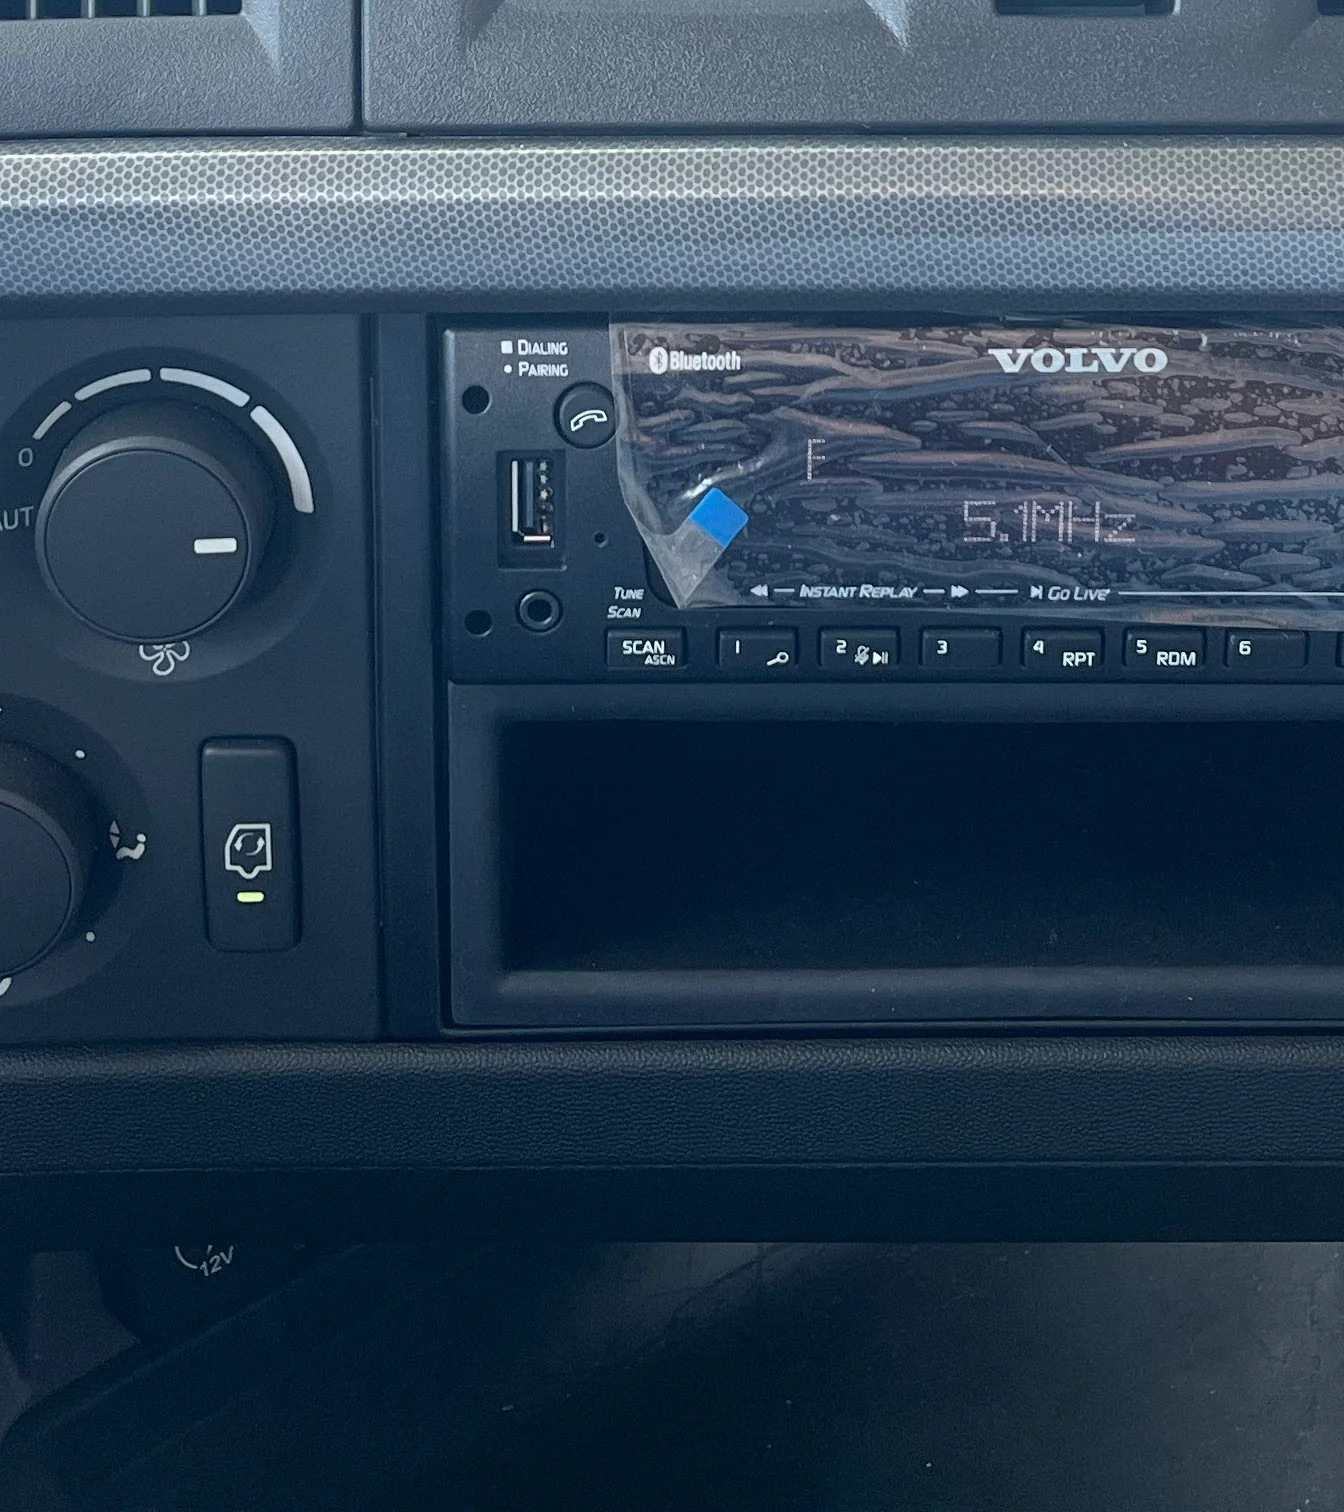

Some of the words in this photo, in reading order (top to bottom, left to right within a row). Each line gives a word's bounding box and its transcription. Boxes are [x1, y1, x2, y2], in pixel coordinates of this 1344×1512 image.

[518, 339, 568, 355] DIALING
[670, 350, 741, 370] Bluetooth
[988, 347, 1168, 374] VOLVO
[518, 361, 568, 377] PAIRING
[614, 586, 644, 600] TUNE
[799, 584, 856, 598] INSTANT
[859, 584, 918, 599] REPLAY
[607, 605, 641, 619] SCAN
[622, 640, 666, 655] SCAN
[734, 640, 741, 654] 1
[836, 639, 847, 654] 2
[937, 640, 948, 655] 3
[1032, 640, 1045, 655] 4
[1062, 652, 1096, 667] RPT
[1136, 640, 1148, 654] 5
[1157, 652, 1196, 666] RDM
[1239, 641, 1251, 655] 6
[644, 654, 676, 666] ASCN
[199, 1245, 233, 1276] 12V
